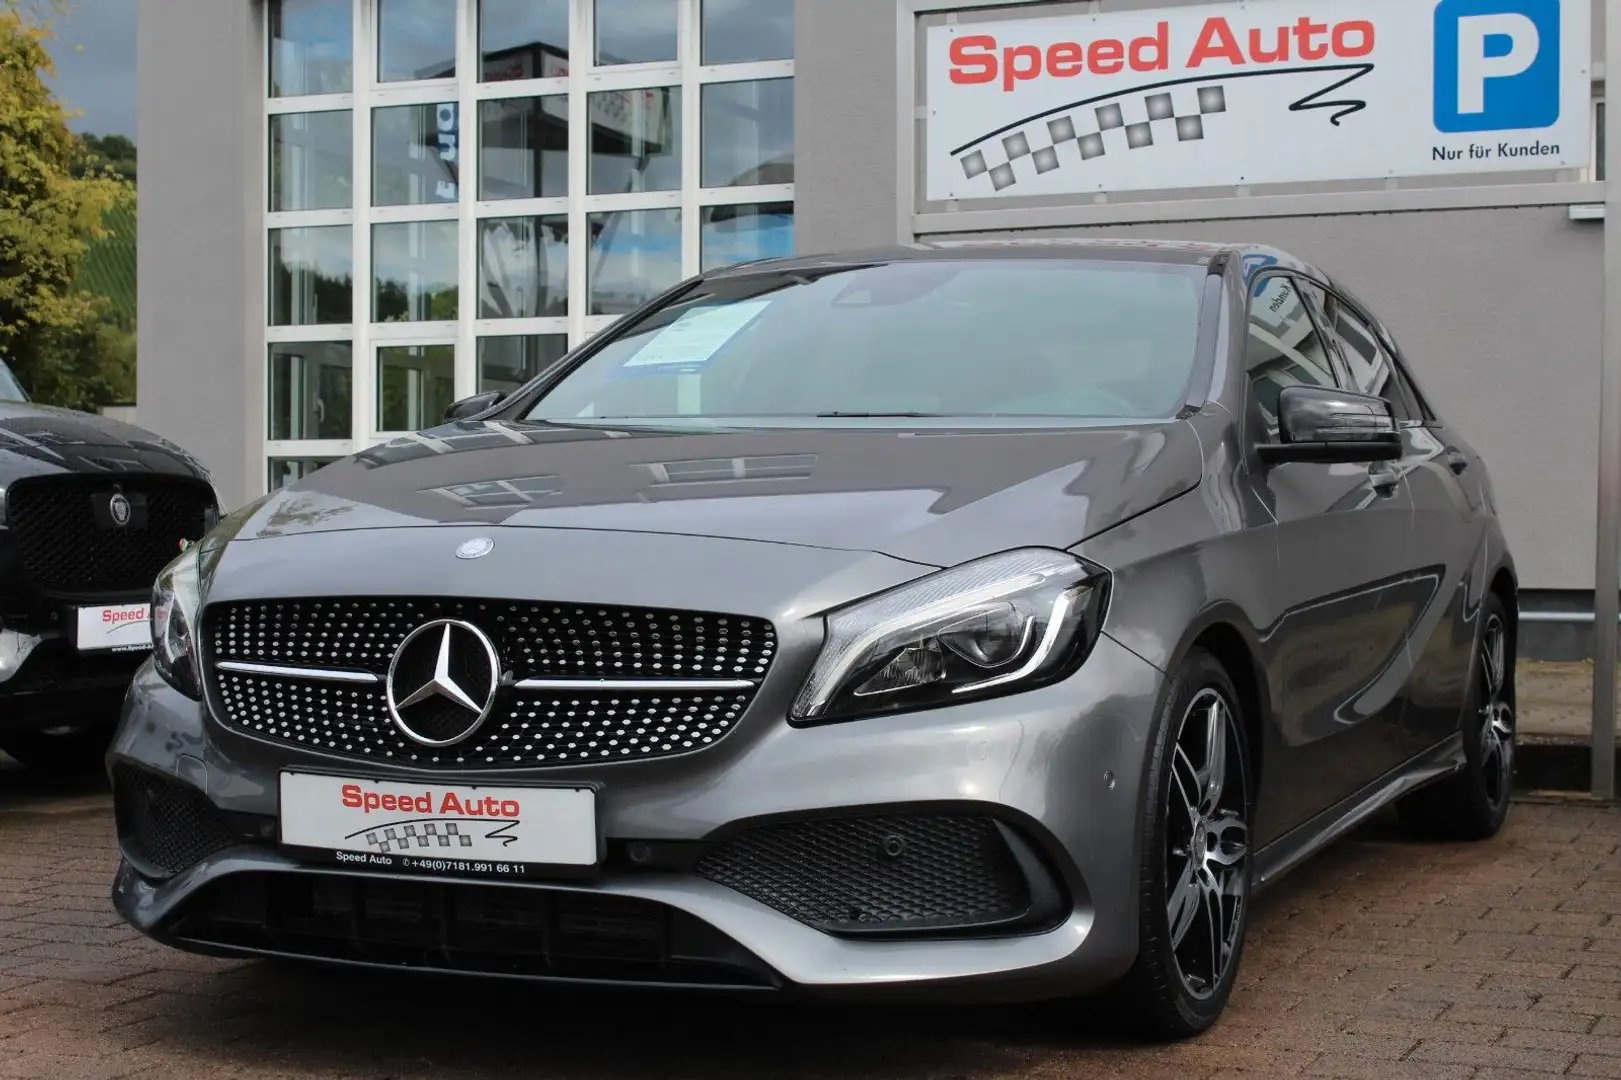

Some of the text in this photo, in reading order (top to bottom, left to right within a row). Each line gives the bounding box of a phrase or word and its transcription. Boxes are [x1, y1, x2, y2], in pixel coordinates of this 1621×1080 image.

[949, 17, 1375, 92] Speed Auto
[1458, 13, 1540, 114] P
[1432, 140, 1560, 161] Nur für Kunden
[102, 608, 145, 624] Speed
[341, 784, 520, 817] Speed Auto
[336, 852, 367, 863] Speed
[369, 853, 392, 865] Auto
[496, 865, 510, 873] 66
[513, 865, 525, 873] 11
